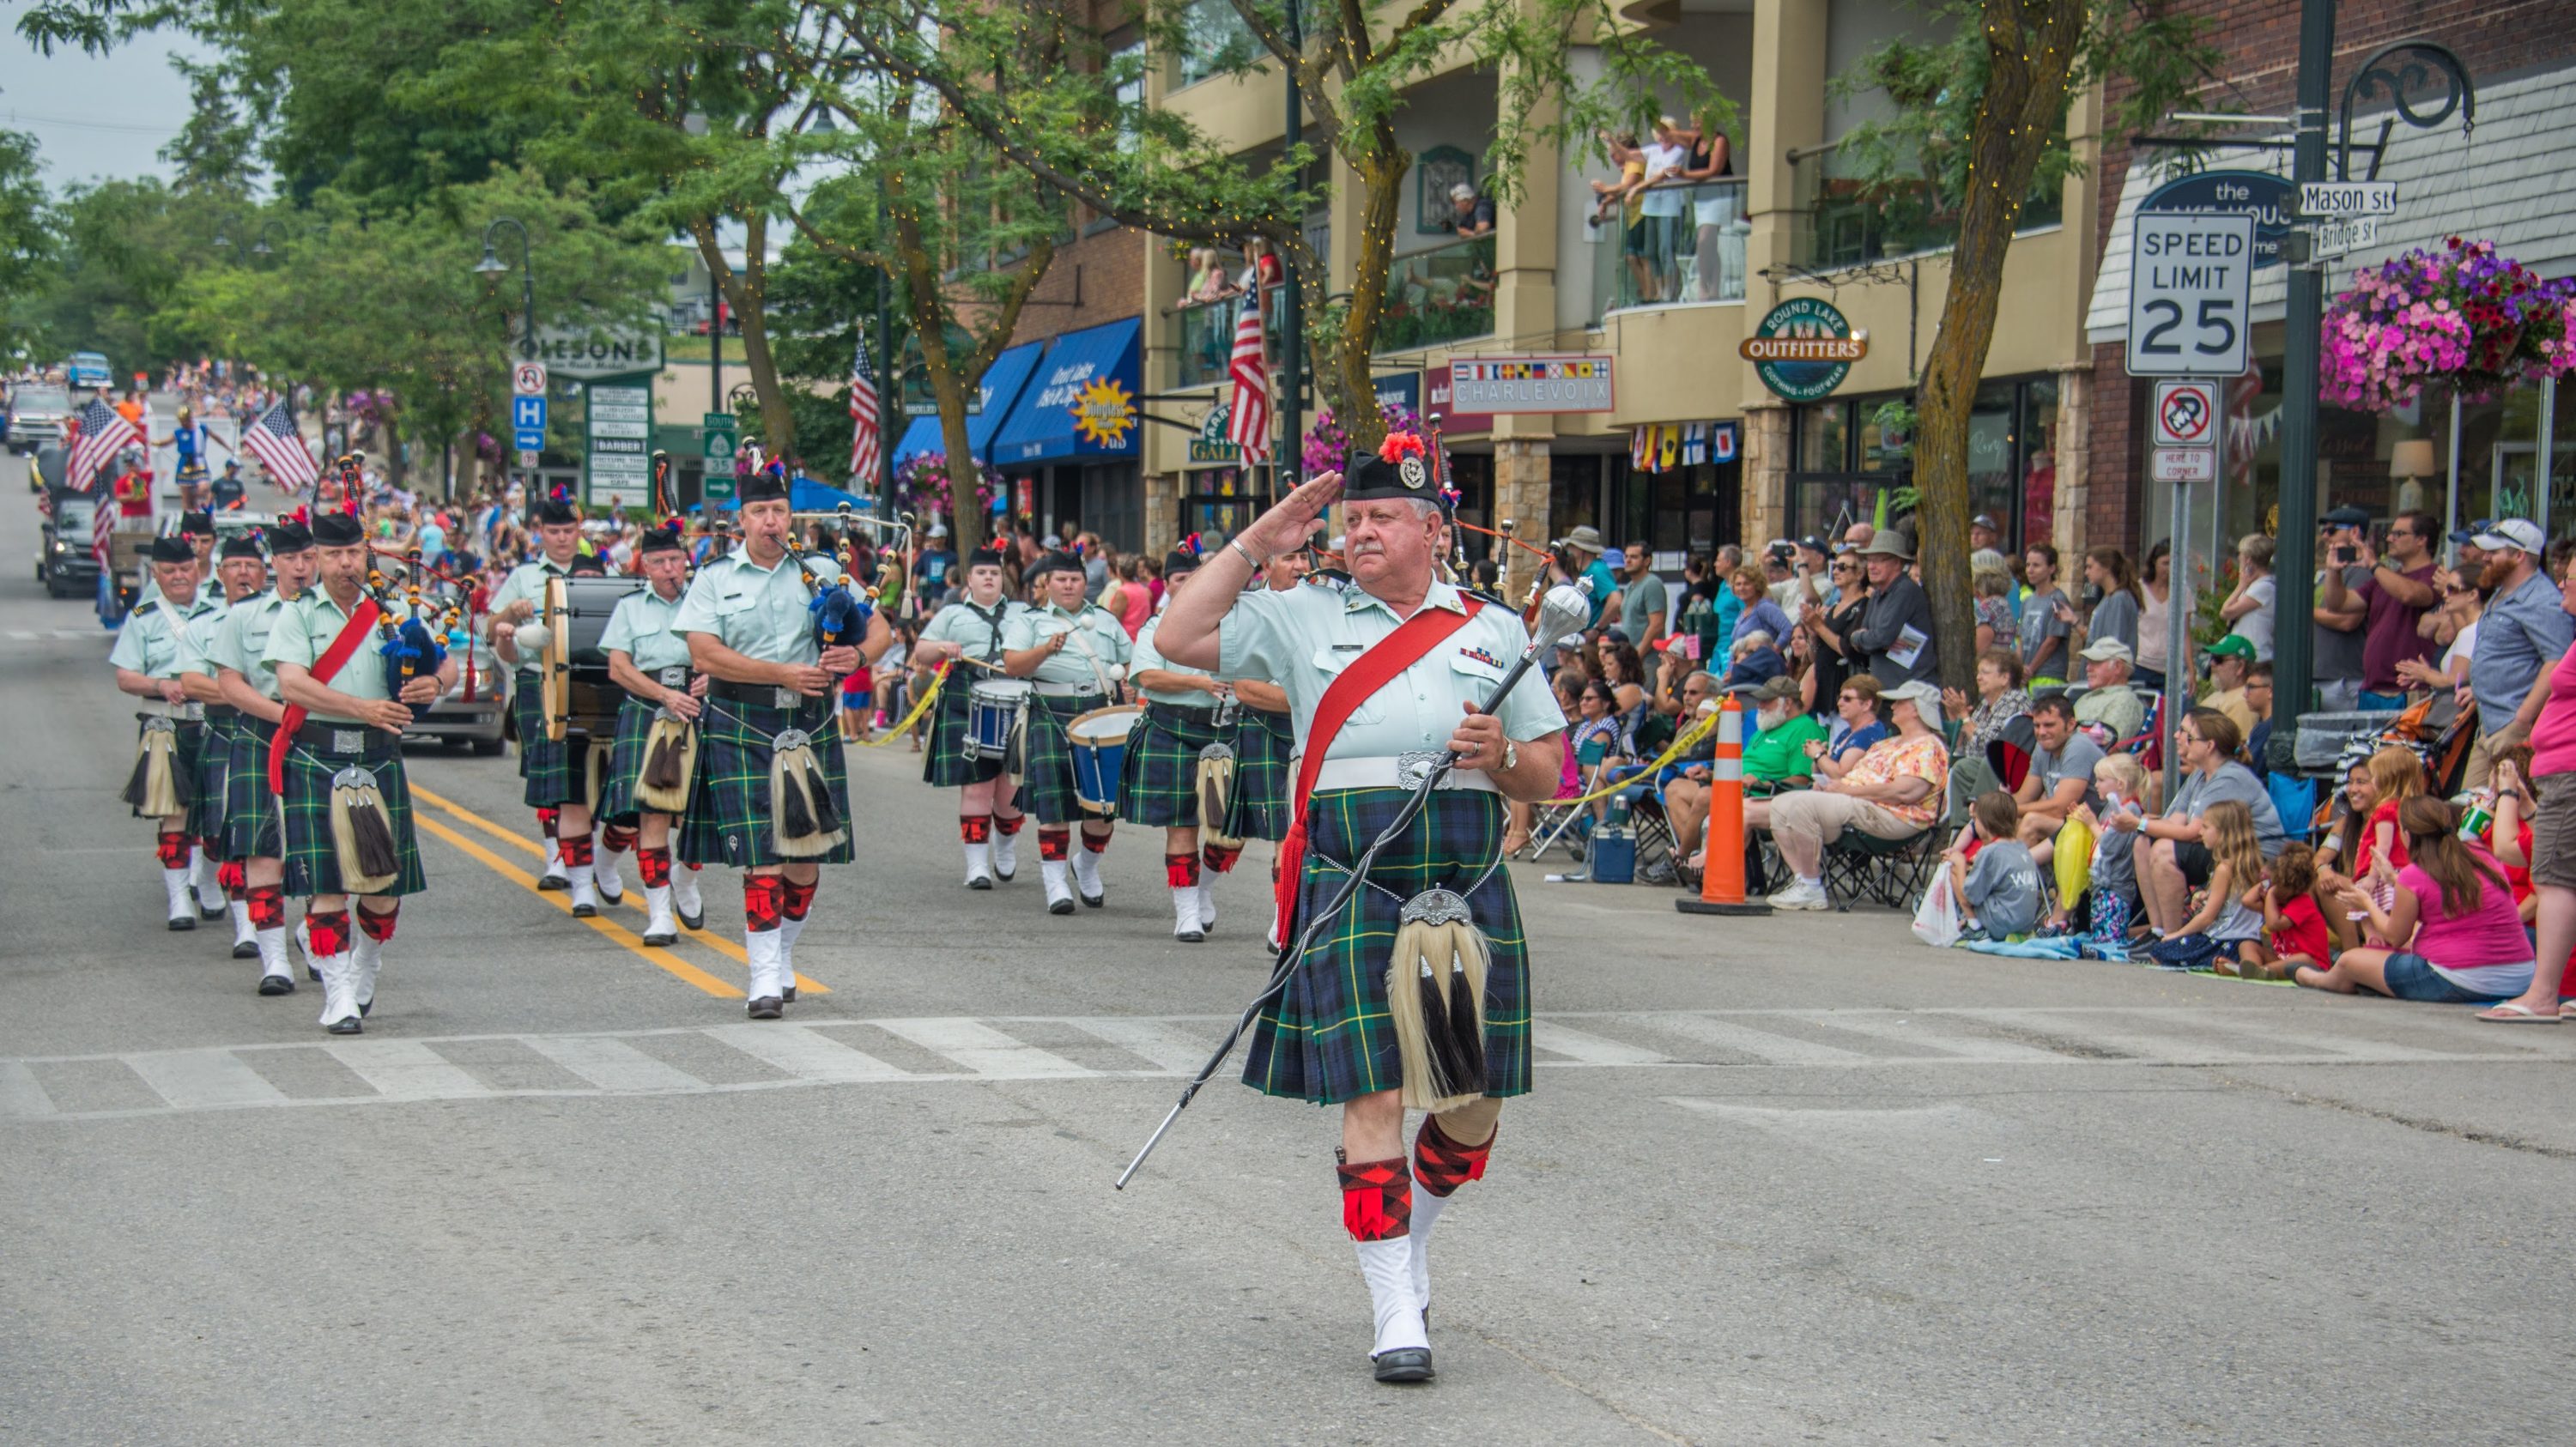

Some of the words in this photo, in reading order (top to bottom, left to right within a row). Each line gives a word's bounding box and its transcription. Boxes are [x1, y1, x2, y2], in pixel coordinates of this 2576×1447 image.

[2215, 182, 2250, 201] the
[2306, 185, 2364, 211] Mason
[2372, 191, 2391, 210] st
[2143, 233, 2243, 257] SPEED
[2322, 222, 2359, 249] Bridge
[2153, 265, 2230, 290] LIMIT
[1766, 302, 1810, 331] ROUND
[1815, 303, 1845, 332] LAKE
[2140, 299, 2236, 355] 25
[1749, 341, 1860, 358] OUTFITTERS
[1764, 365, 1797, 396] CLOTHING
[1803, 365, 1845, 396] FOOTWEAR
[1456, 383, 1608, 403] CHARLEVOIX
[520, 401, 541, 426] H
[706, 415, 734, 427] SOUTH
[1083, 397, 1126, 421] Sunglass
[598, 439, 641, 452] BARBER
[712, 459, 730, 472] 35
[2166, 453, 2185, 463] HERE
[2191, 453, 2200, 463] TO
[2167, 466, 2198, 477] CORNER
